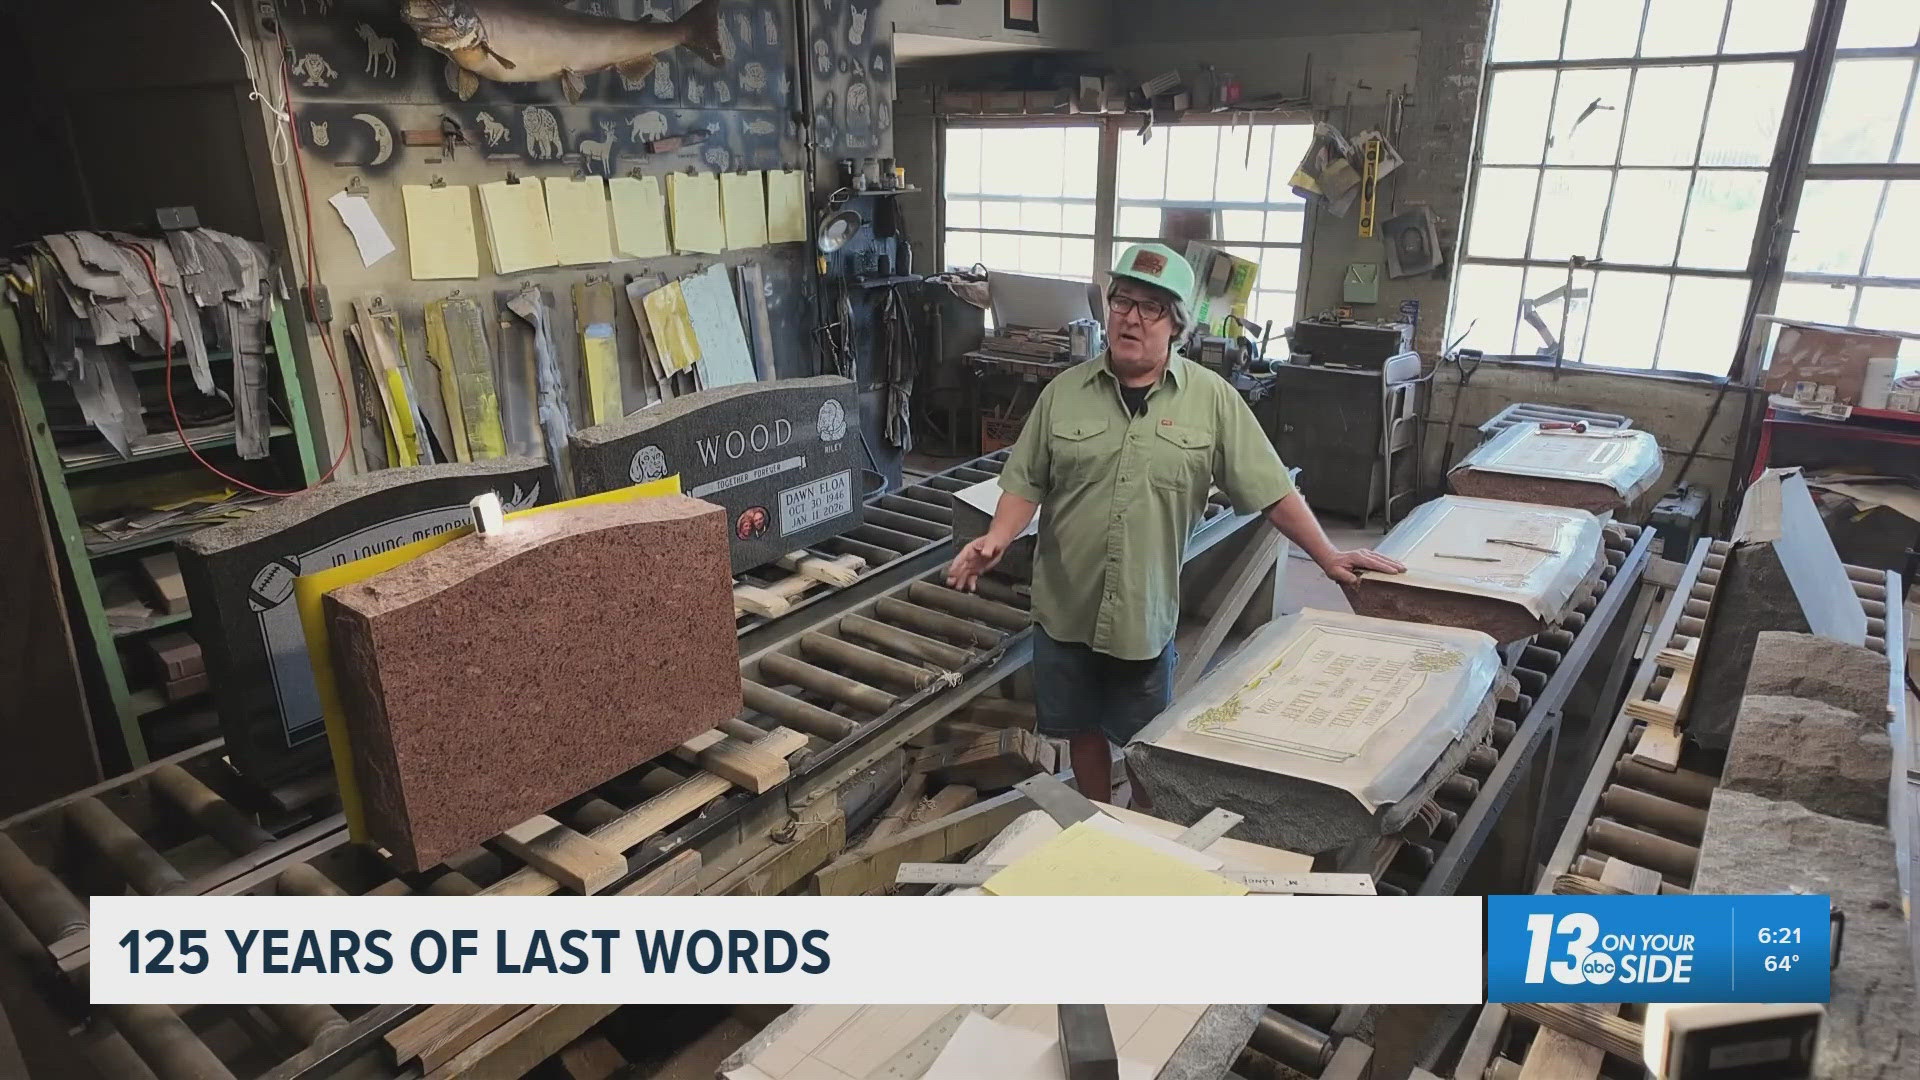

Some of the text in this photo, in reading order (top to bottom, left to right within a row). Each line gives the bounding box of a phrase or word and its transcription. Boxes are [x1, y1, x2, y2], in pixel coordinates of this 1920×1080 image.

[696, 418, 792, 468] WOOD
[824, 443, 843, 454] RILEY
[717, 464, 781, 490] TOGETHER FOREVER
[786, 477, 845, 506] DAWN ELOA
[789, 491, 845, 516] OCT 30 1946
[792, 514, 808, 529] JAN
[823, 502, 844, 516] 2026
